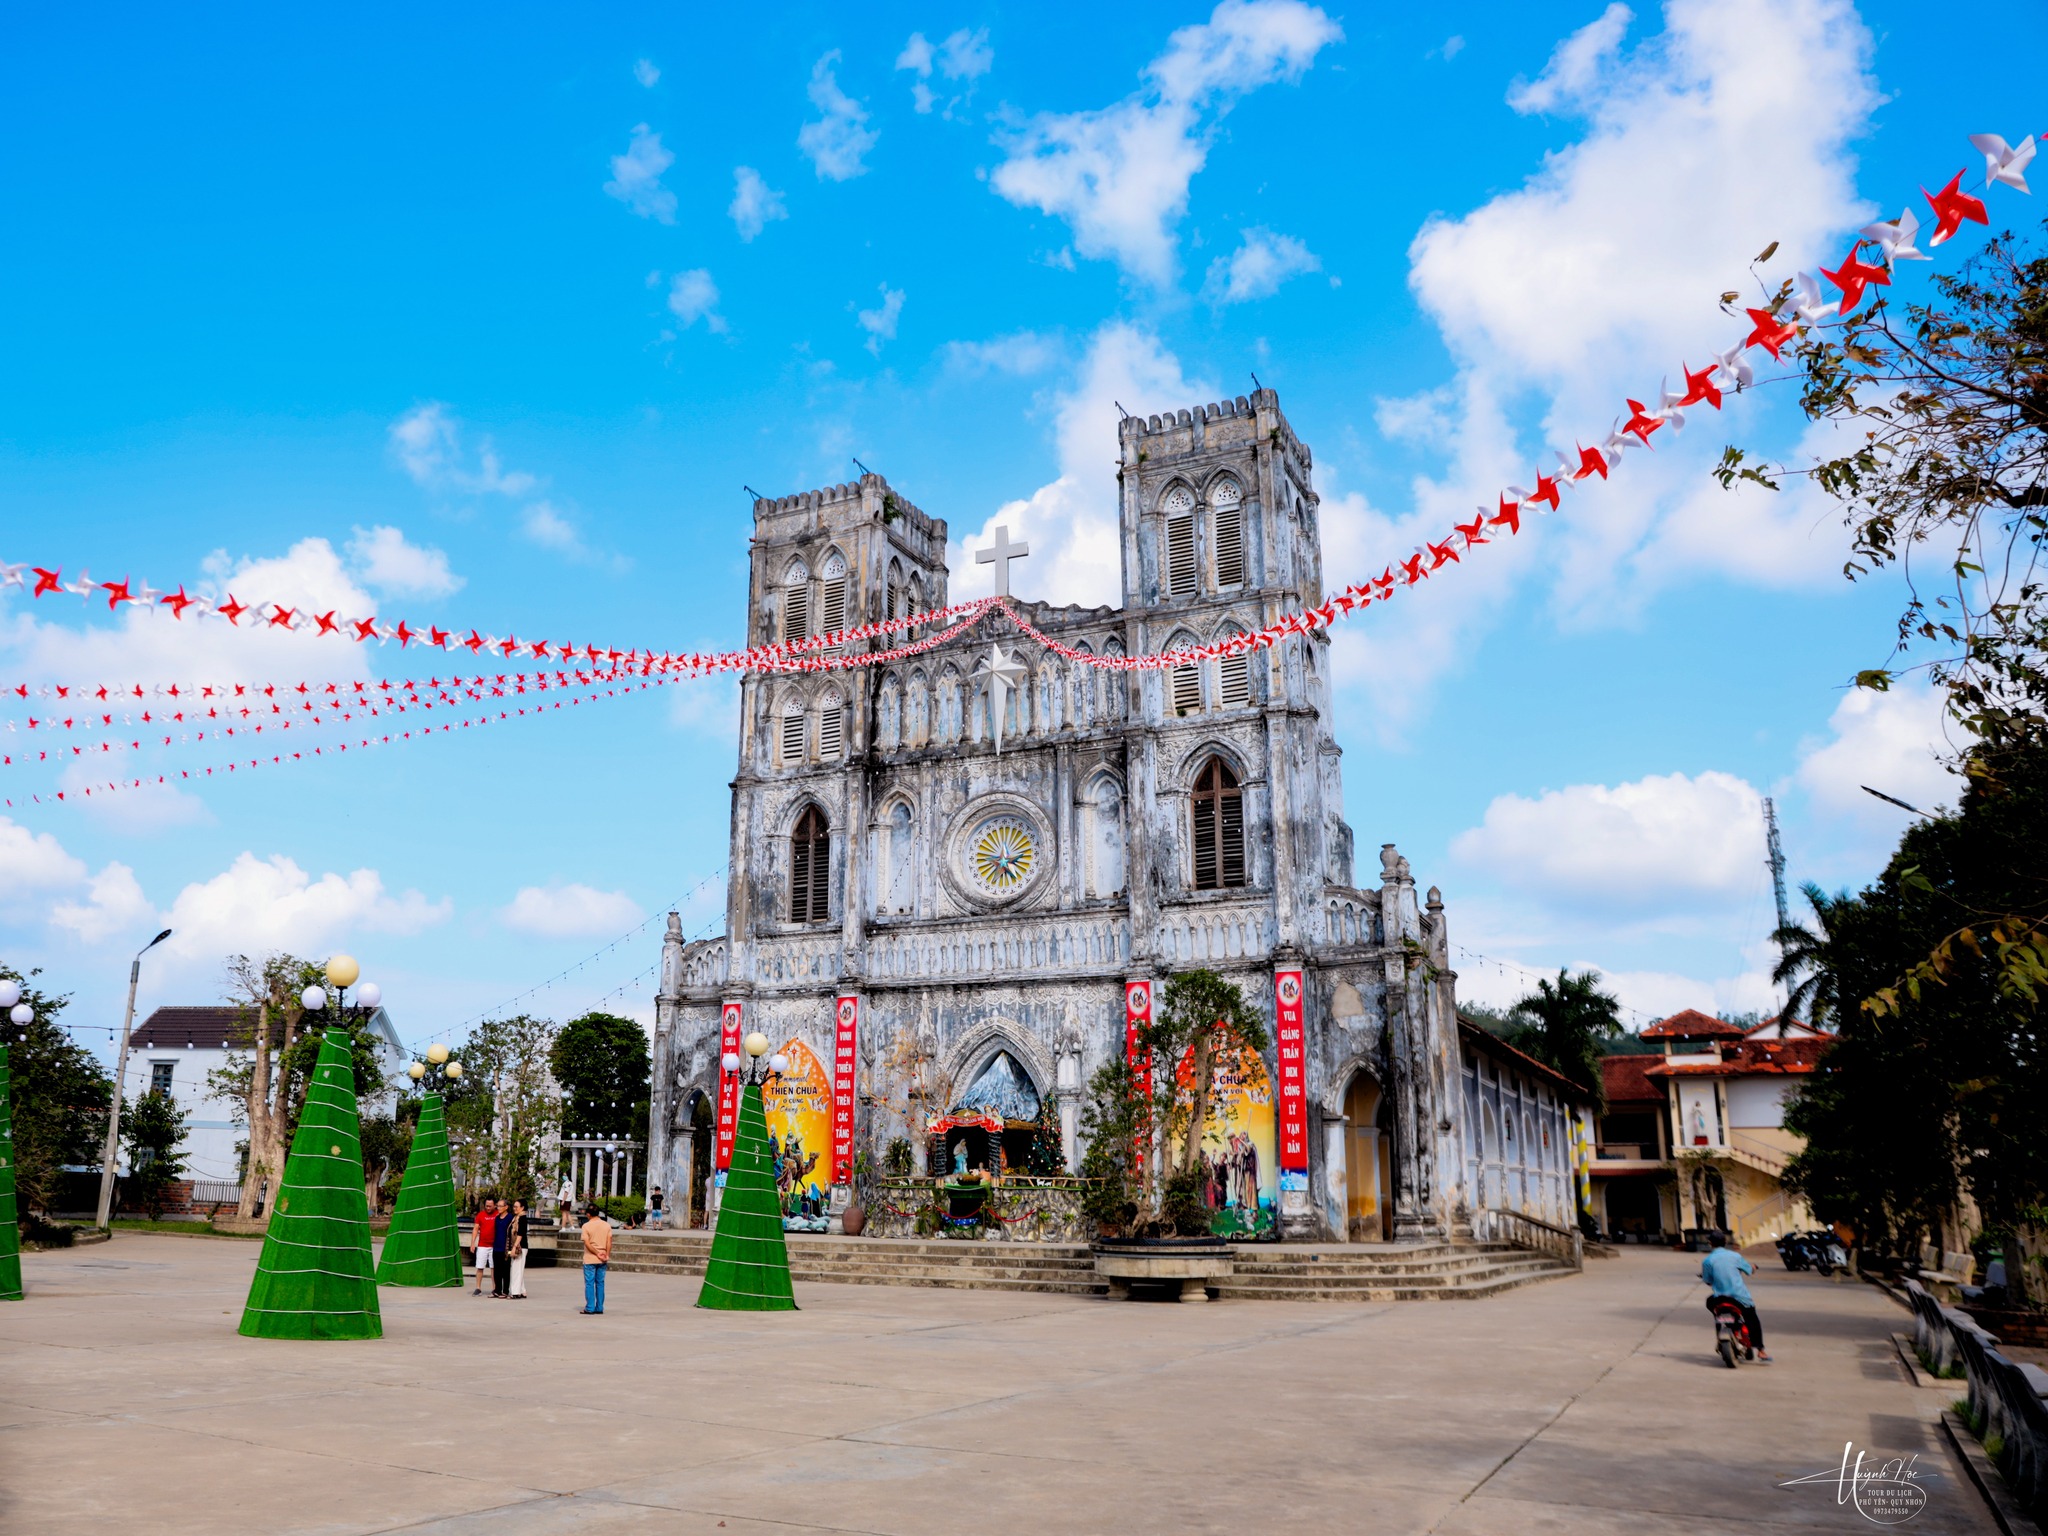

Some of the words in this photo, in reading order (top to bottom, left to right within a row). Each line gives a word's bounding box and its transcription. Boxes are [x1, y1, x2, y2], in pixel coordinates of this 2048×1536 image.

[1283, 1011, 1296, 1021] VUA
[840, 1032, 852, 1041] VINH
[1281, 1027, 1299, 1040] GIÁNG
[838, 1048, 852, 1057] DANH
[837, 1062, 852, 1073] THIÊN
[837, 1078, 851, 1089] CHÚA
[836, 1094, 850, 1106] TRÊN
[837, 1110, 848, 1122] CÁC
[1286, 1123, 1300, 1136] VẠN
